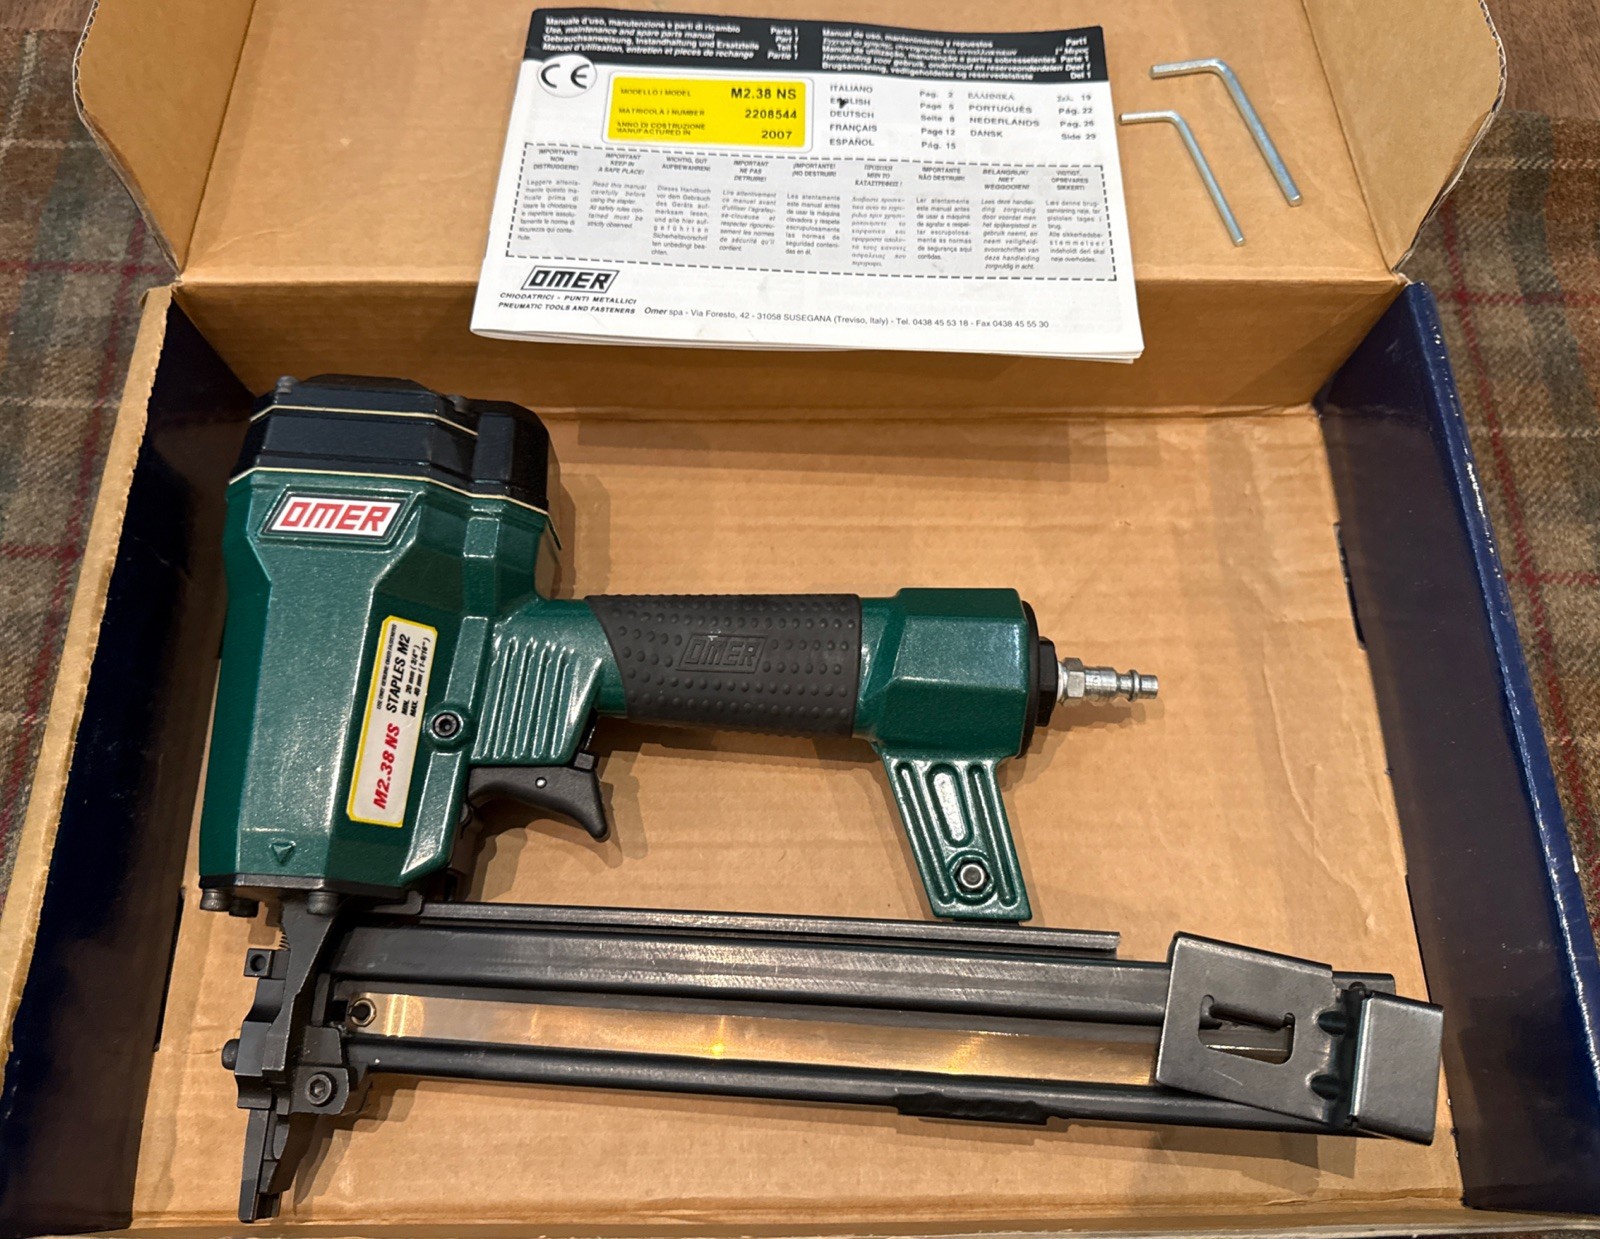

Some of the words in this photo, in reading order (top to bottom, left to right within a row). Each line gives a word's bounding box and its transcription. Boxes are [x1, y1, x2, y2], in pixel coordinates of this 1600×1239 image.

[545, 17, 579, 25] Manuale
[581, 18, 606, 26] d'uso,
[608, 19, 665, 28] manutenzione
[674, 22, 693, 30] parti
[695, 22, 703, 30] di
[705, 24, 740, 33] ricambio
[770, 26, 792, 35] Parte
[545, 27, 563, 35] Use,
[565, 27, 618, 35] maintenance
[684, 32, 715, 40] manual
[822, 28, 852, 37] Manual
[885, 35, 944, 46] mantenimiento
[952, 40, 993, 49] repuestos
[543, 35, 634, 46] Gebrauchsanweisung,
[636, 38, 697, 48] Instandhaltung
[699, 40, 715, 48] und
[717, 41, 760, 50] Ersatzteile
[626, 46, 663, 54] entretien
[716, 51, 754, 60] rechange
[767, 51, 791, 60] Partie
[822, 54, 871, 63] Handleiding
[928, 62, 973, 70] onderhoud
[967, 56, 992, 64] partes
[822, 62, 888, 74] Brugsanvisning,
[541, 64, 590, 89] CE
[731, 87, 772, 99] M2.38
[777, 88, 797, 100] NS
[830, 85, 873, 94] ITALIANO
[745, 109, 797, 119] 2208544
[830, 110, 874, 118] DEUTSCH
[969, 105, 1032, 114] PORTUGUÊS
[830, 124, 878, 133] FRANÇAIS
[969, 117, 1040, 127] NEDERLANDS
[762, 130, 792, 140] 2007
[921, 128, 943, 136] Page
[970, 130, 1003, 138] DANSK
[830, 138, 875, 146] ESPAÑOL
[528, 270, 612, 290] OMER
[500, 292, 554, 300] CHIODATRICI
[592, 296, 636, 305] METALLICI
[590, 306, 636, 314] FASTENERS
[644, 306, 667, 315] Omer
[706, 310, 738, 319] Foresto,
[783, 314, 832, 322] SUSEGANA
[834, 315, 868, 325] (Treviso,
[870, 317, 888, 326] Italy)
[280, 501, 392, 532] OMER
[684, 638, 760, 666] OMER
[386, 656, 406, 713] STAPLES
[397, 633, 410, 655] M2
[416, 674, 423, 687] mm
[401, 699, 410, 715] MIN.
[406, 684, 412, 694] 20
[409, 671, 415, 684] mm
[373, 750, 396, 810] M2.38
[386, 722, 400, 750] NS
